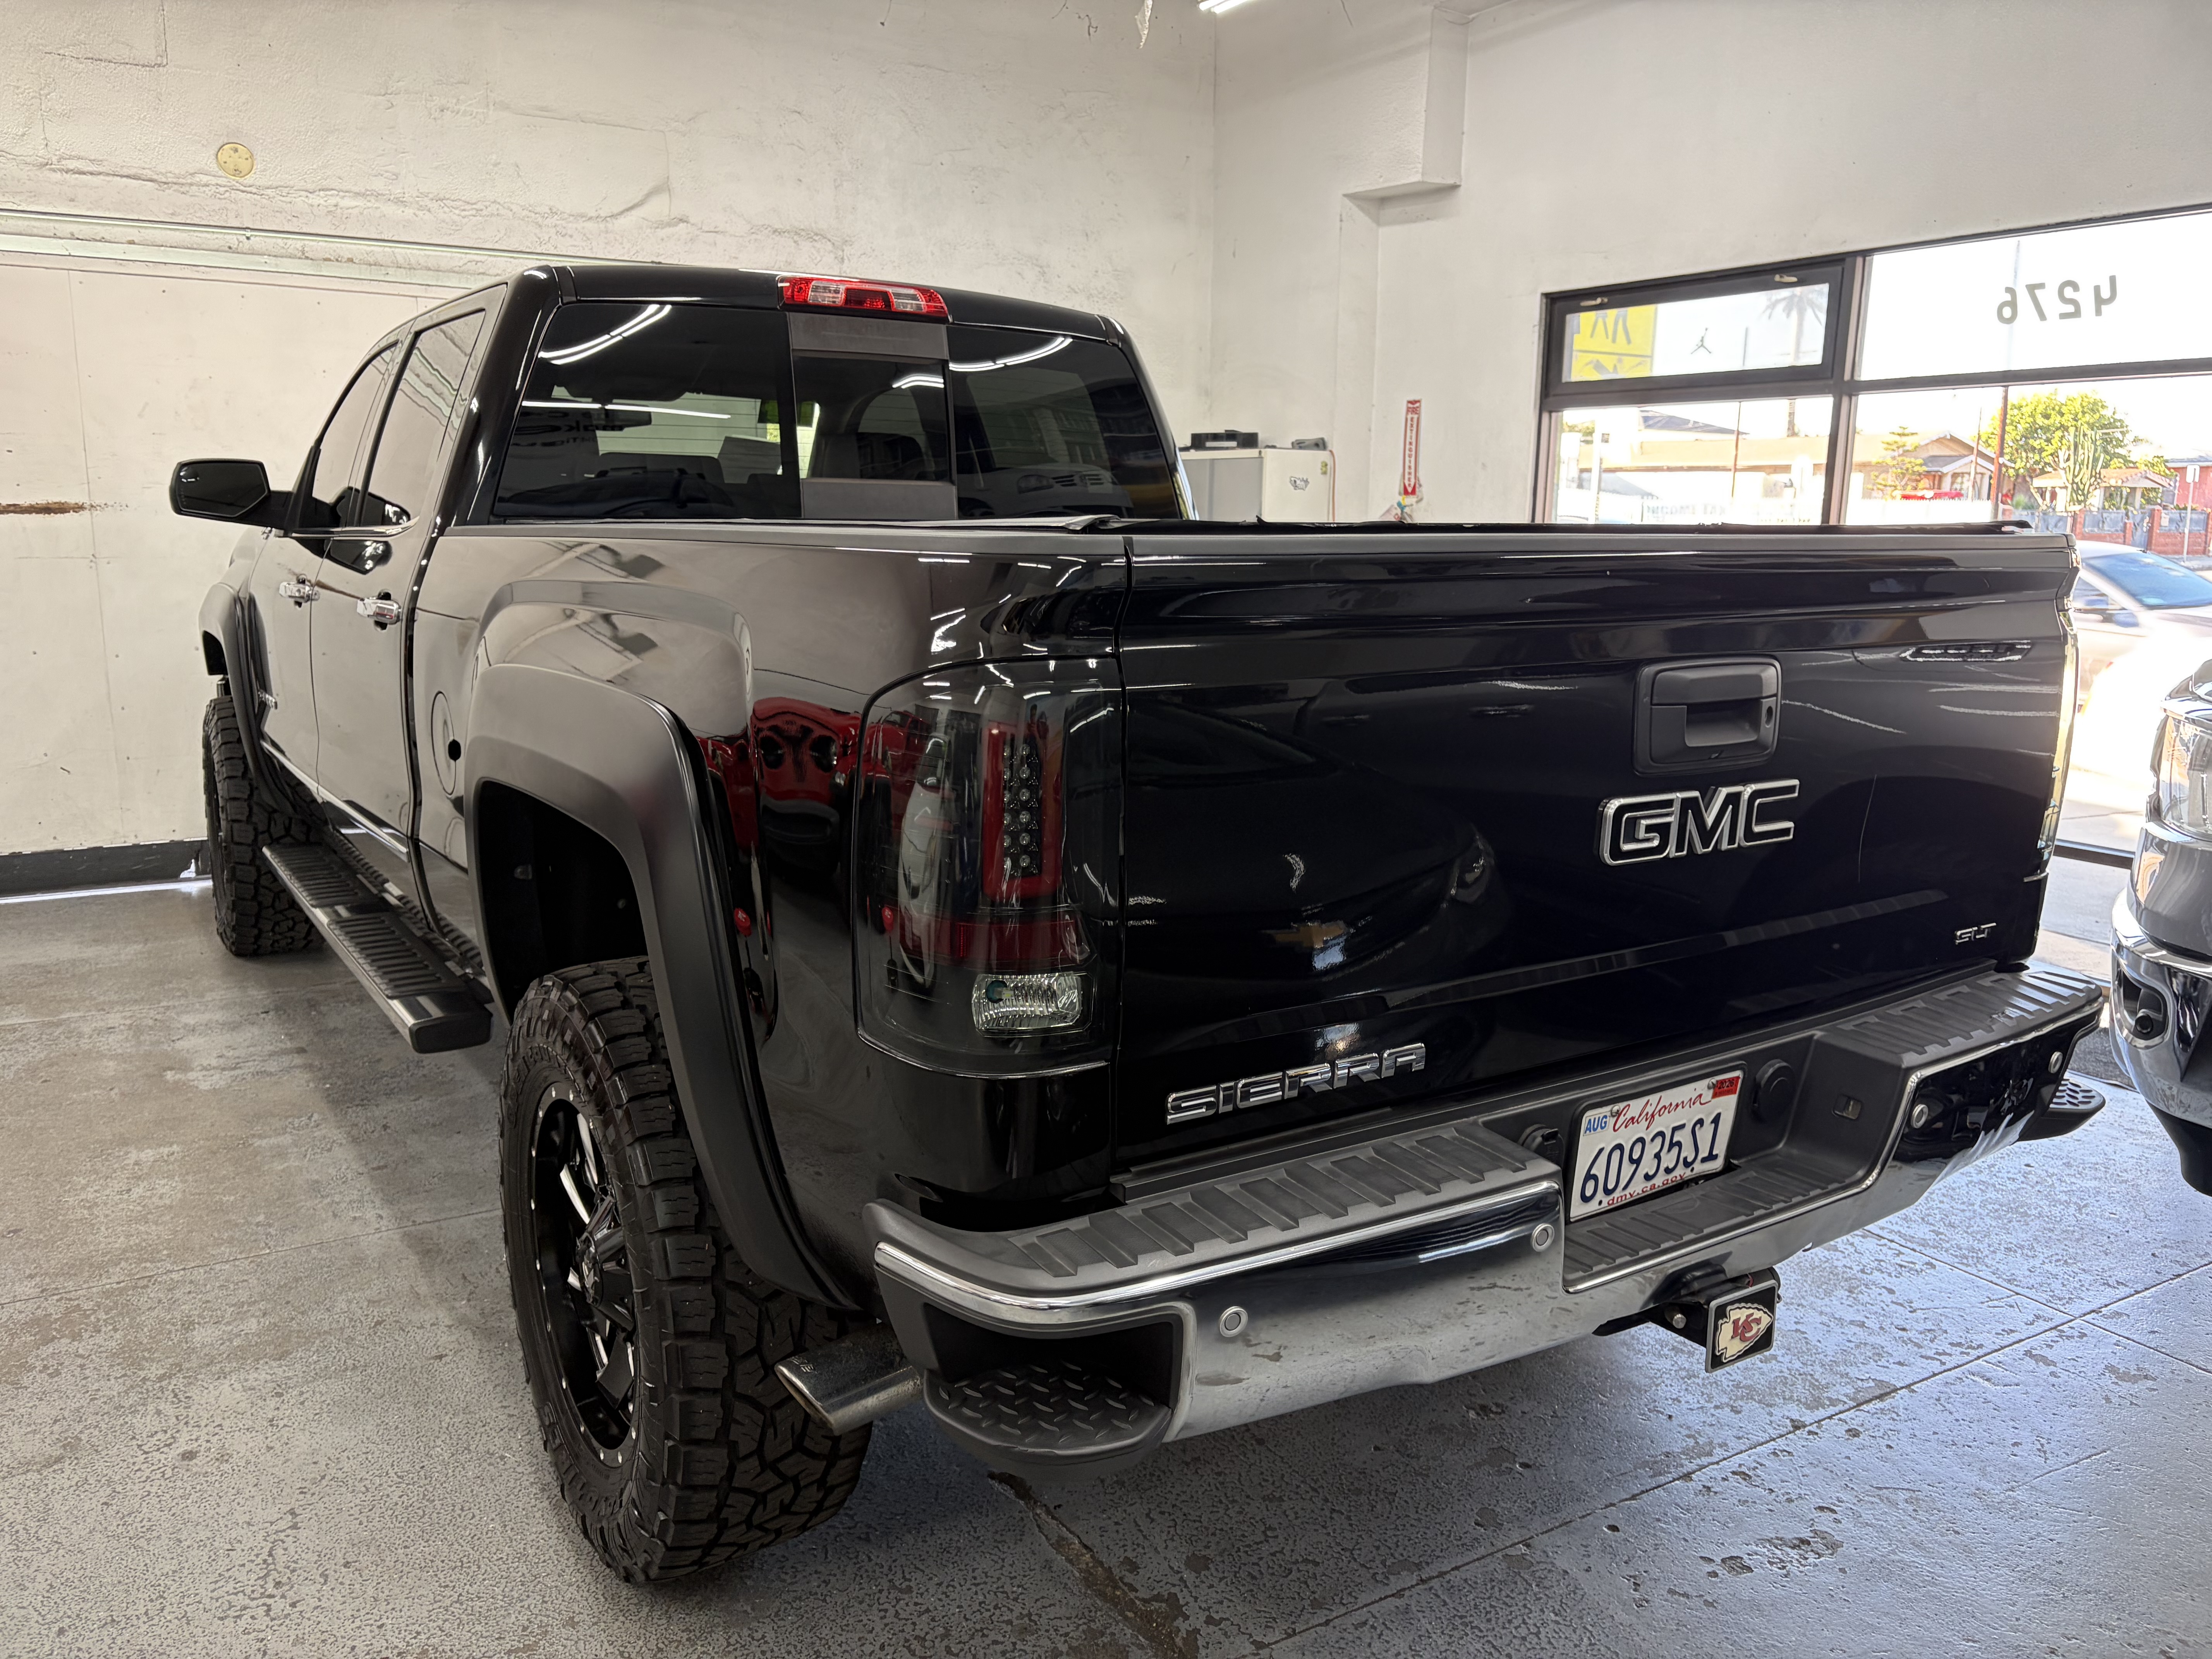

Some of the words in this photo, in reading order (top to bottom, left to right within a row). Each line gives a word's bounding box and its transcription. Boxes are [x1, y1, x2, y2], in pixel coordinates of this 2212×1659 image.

[1599, 778, 1800, 866] GMC
[1955, 922, 1997, 945] SLT
[1166, 1042, 1426, 1125] SIERRA
[1718, 1079, 1735, 1089] 2026
[1584, 1115, 1608, 1133] AUG
[1613, 1087, 1712, 1133] California
[1580, 1112, 1722, 1203] 60935S1
[1607, 1172, 1686, 1206] dmv.ca.gov
[1731, 1312, 1762, 1341] KC
